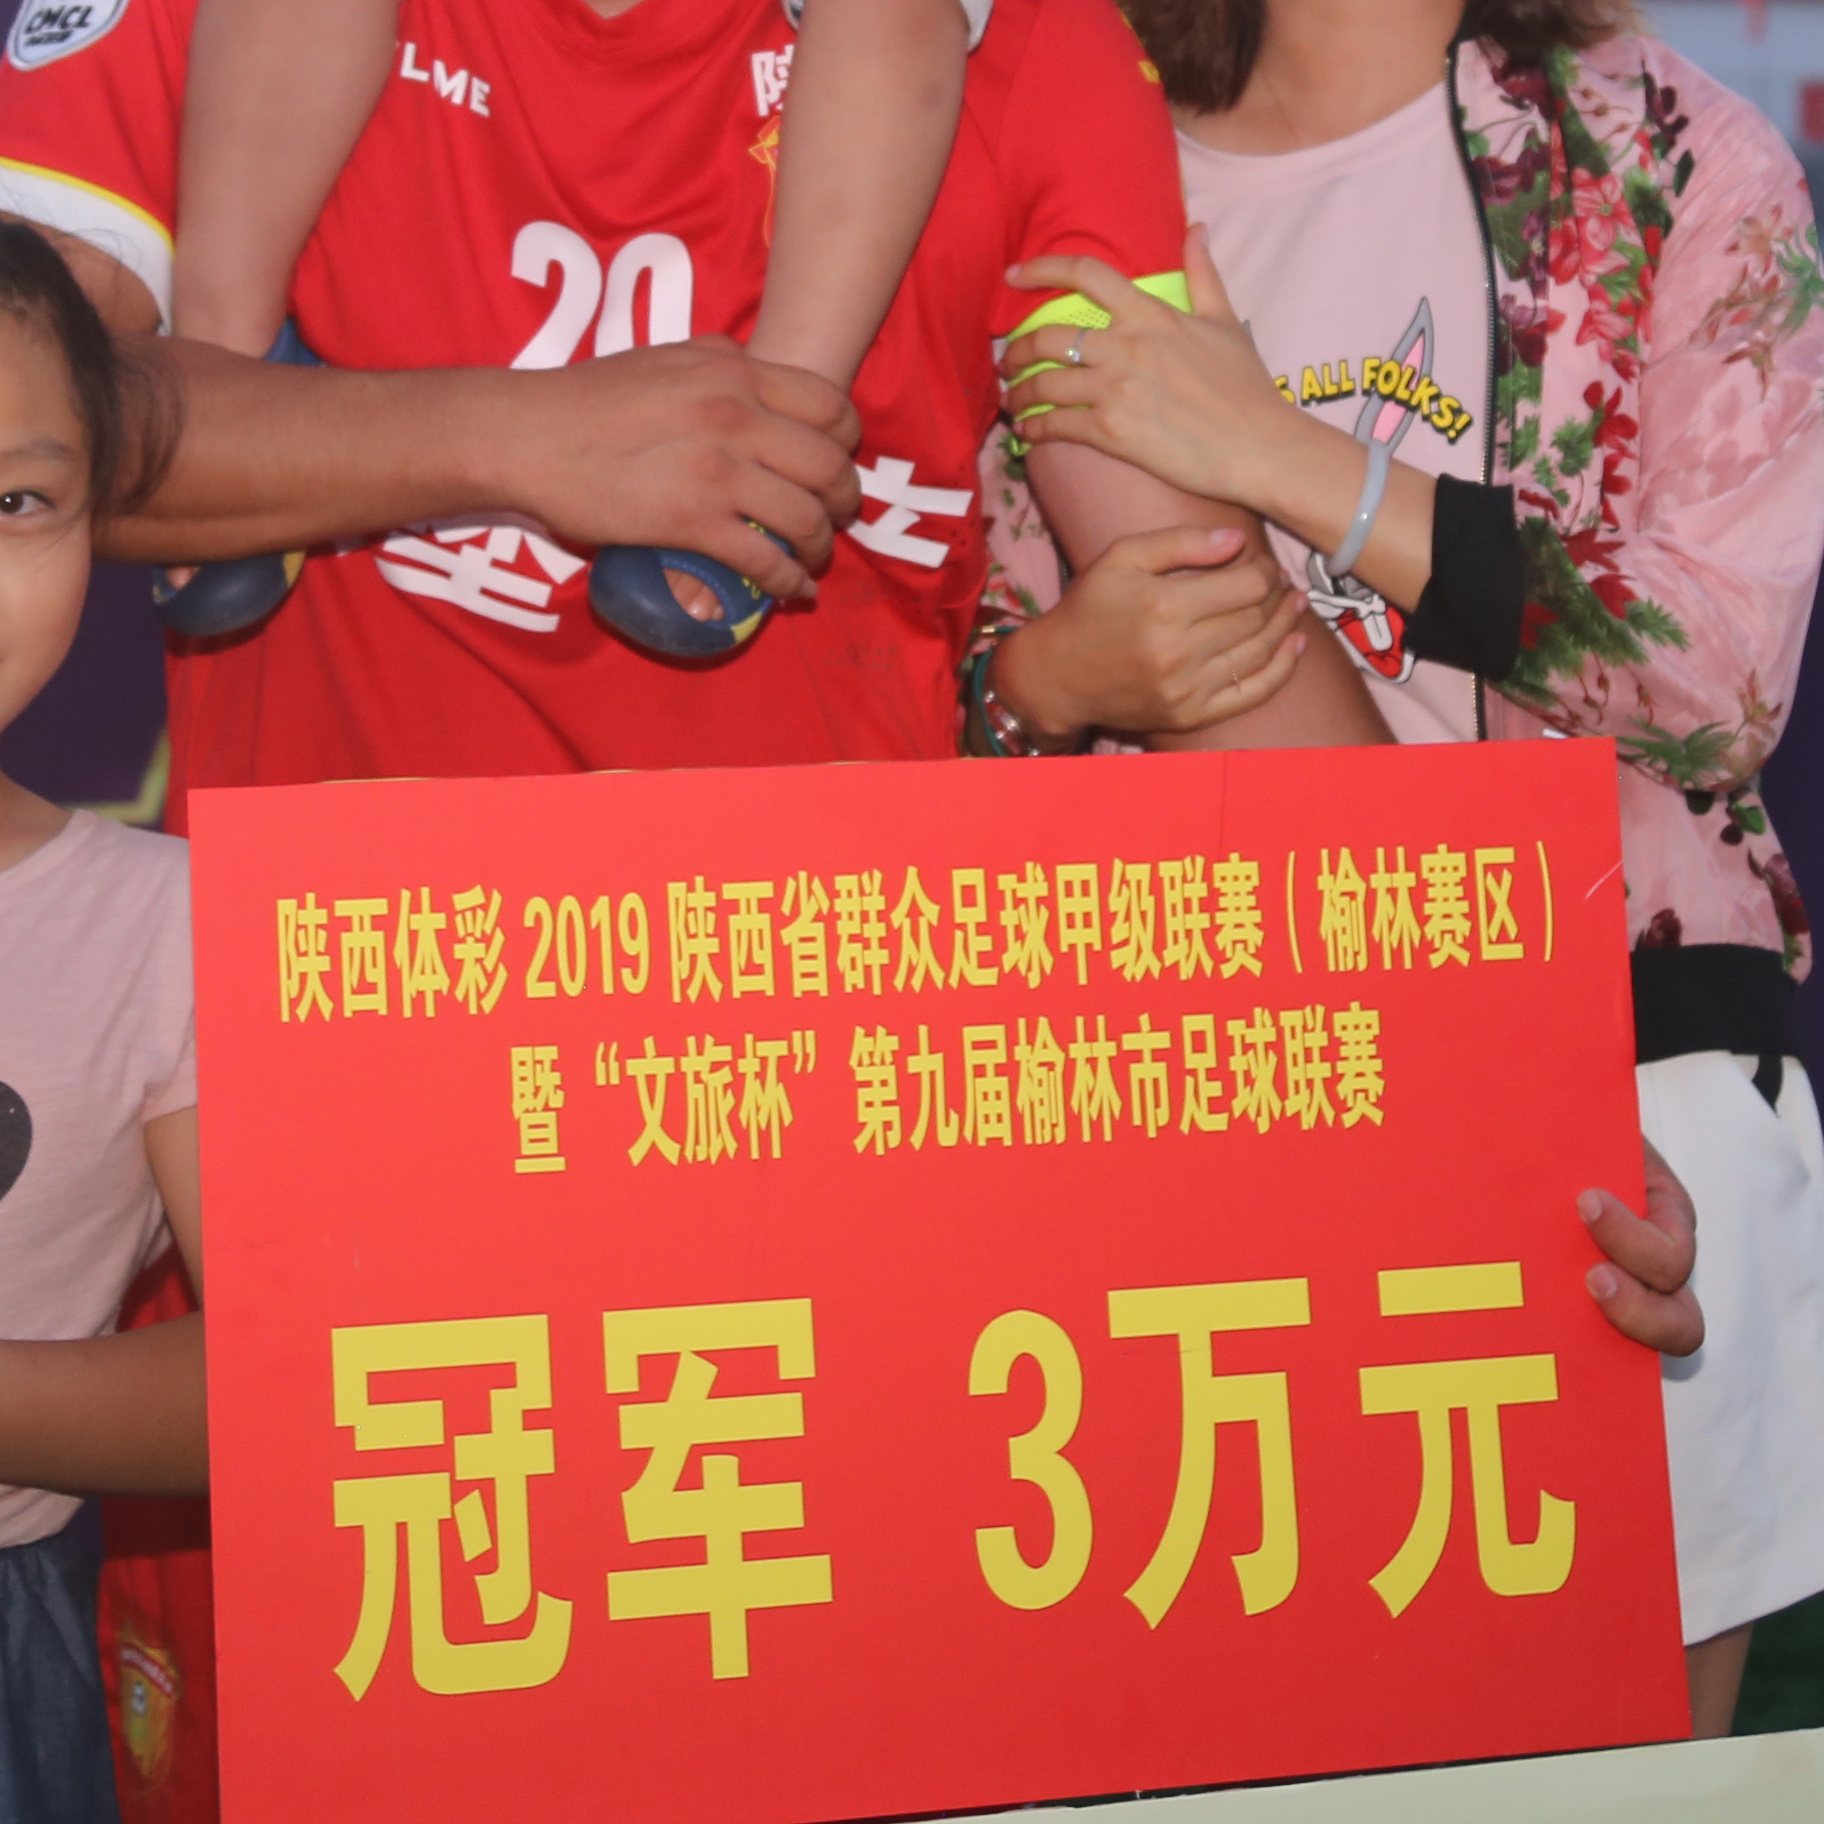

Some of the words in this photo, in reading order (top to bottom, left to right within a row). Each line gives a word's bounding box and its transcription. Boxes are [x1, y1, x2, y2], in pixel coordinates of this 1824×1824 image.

[399, 41, 492, 117] LME
[509, 220, 694, 370] 20
[1299, 360, 1357, 407] ALL
[1360, 356, 1474, 446] FOLKS!
[330, 1297, 833, 1702] 冠军
[967, 1262, 1576, 1630] 3万元
